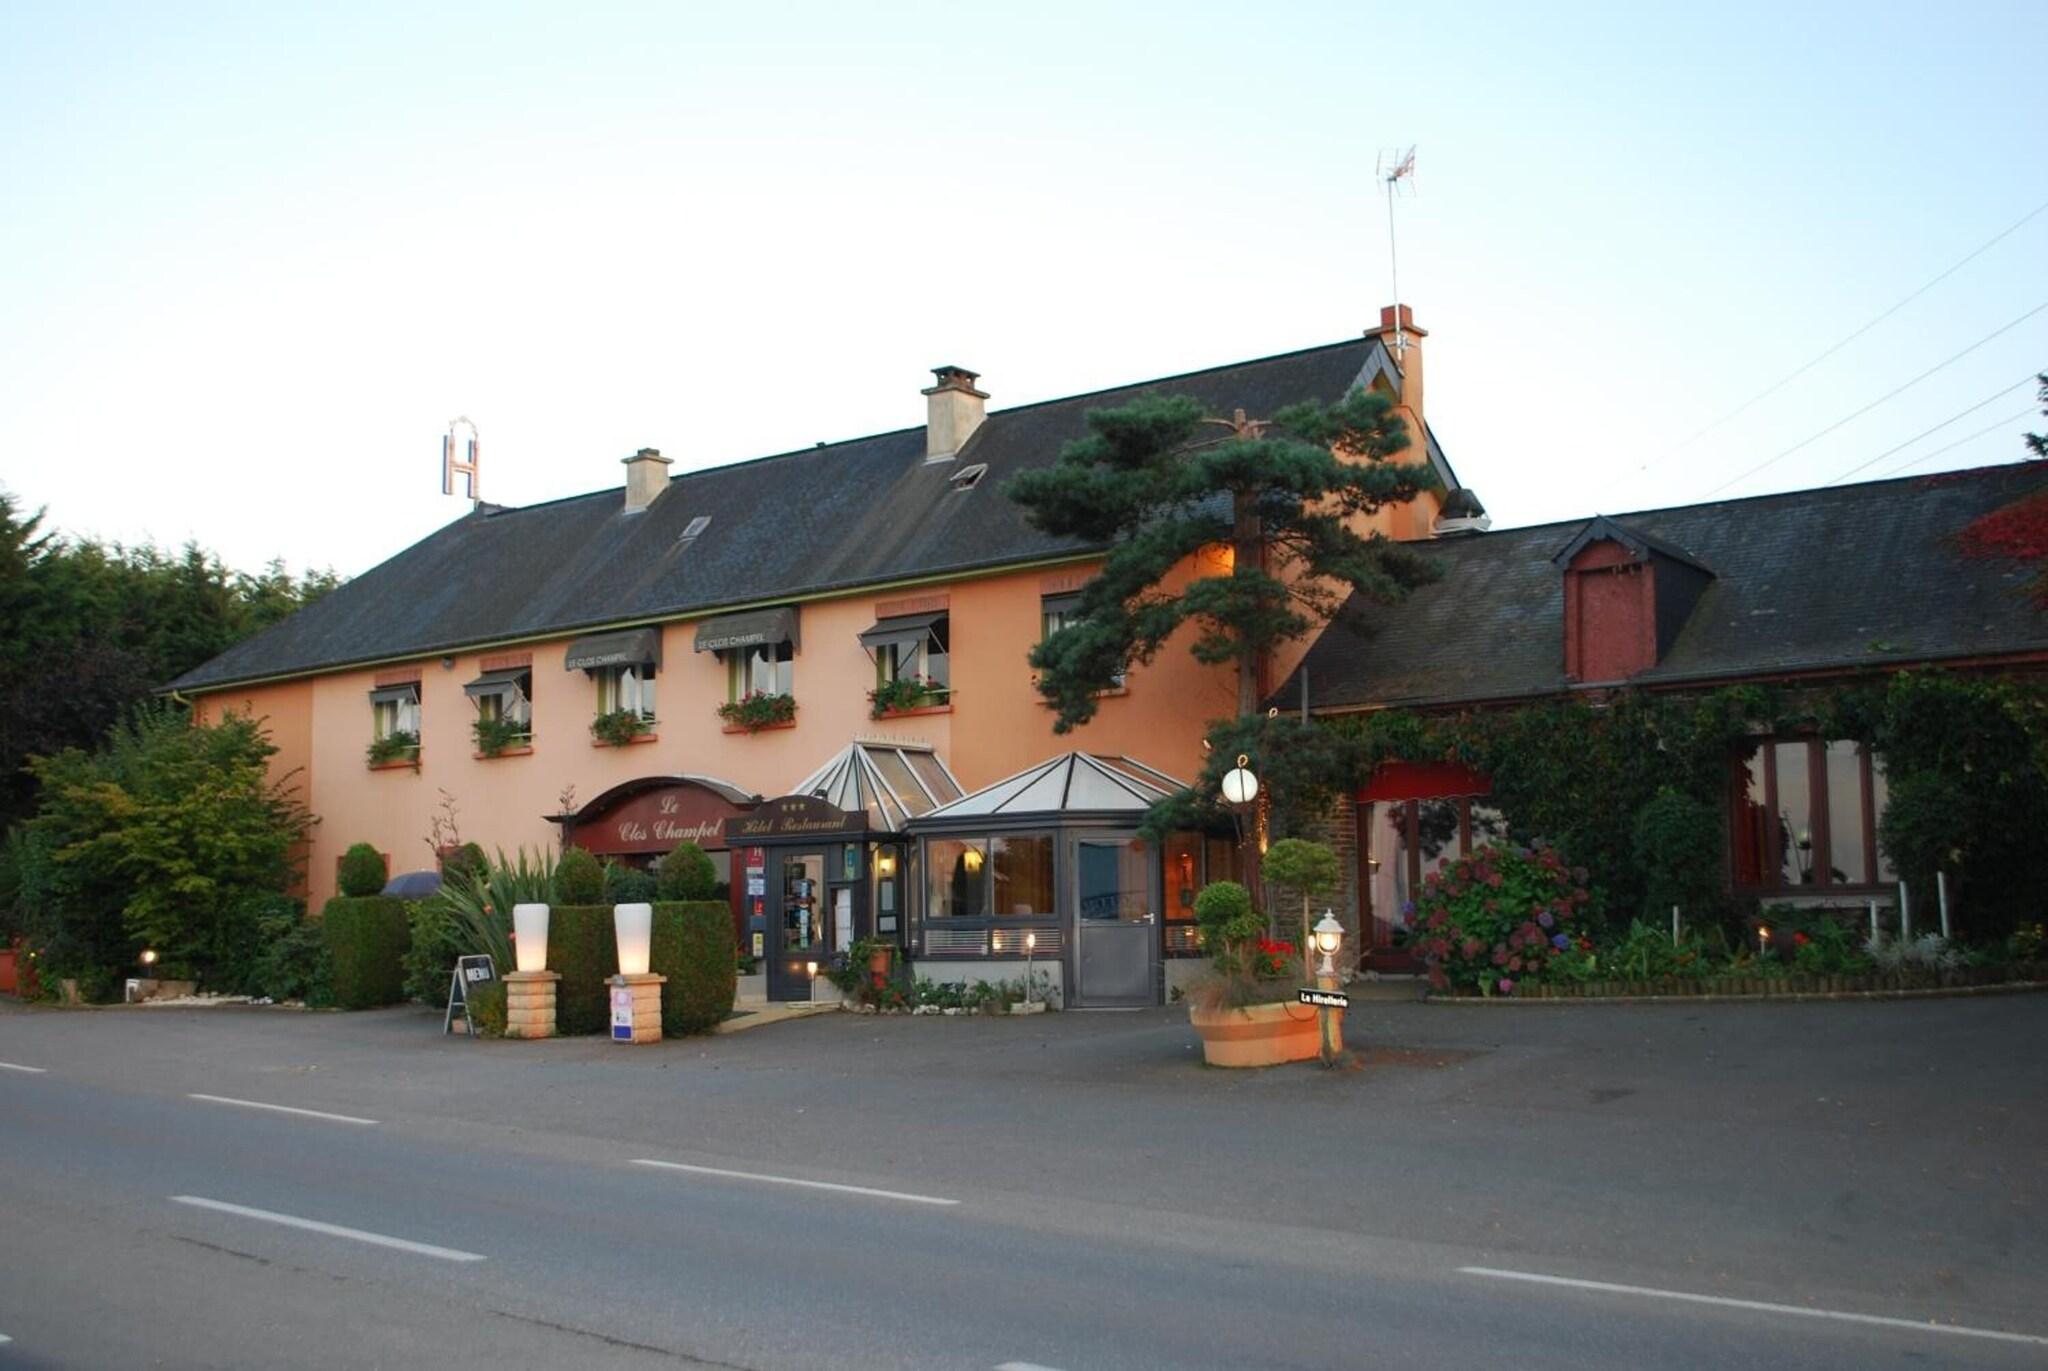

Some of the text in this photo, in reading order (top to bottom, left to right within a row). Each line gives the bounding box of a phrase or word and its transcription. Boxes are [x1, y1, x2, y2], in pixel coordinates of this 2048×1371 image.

[660, 795, 679, 814] Le
[618, 818, 724, 844] Clos Champel
[780, 815, 848, 832] Restaurant
